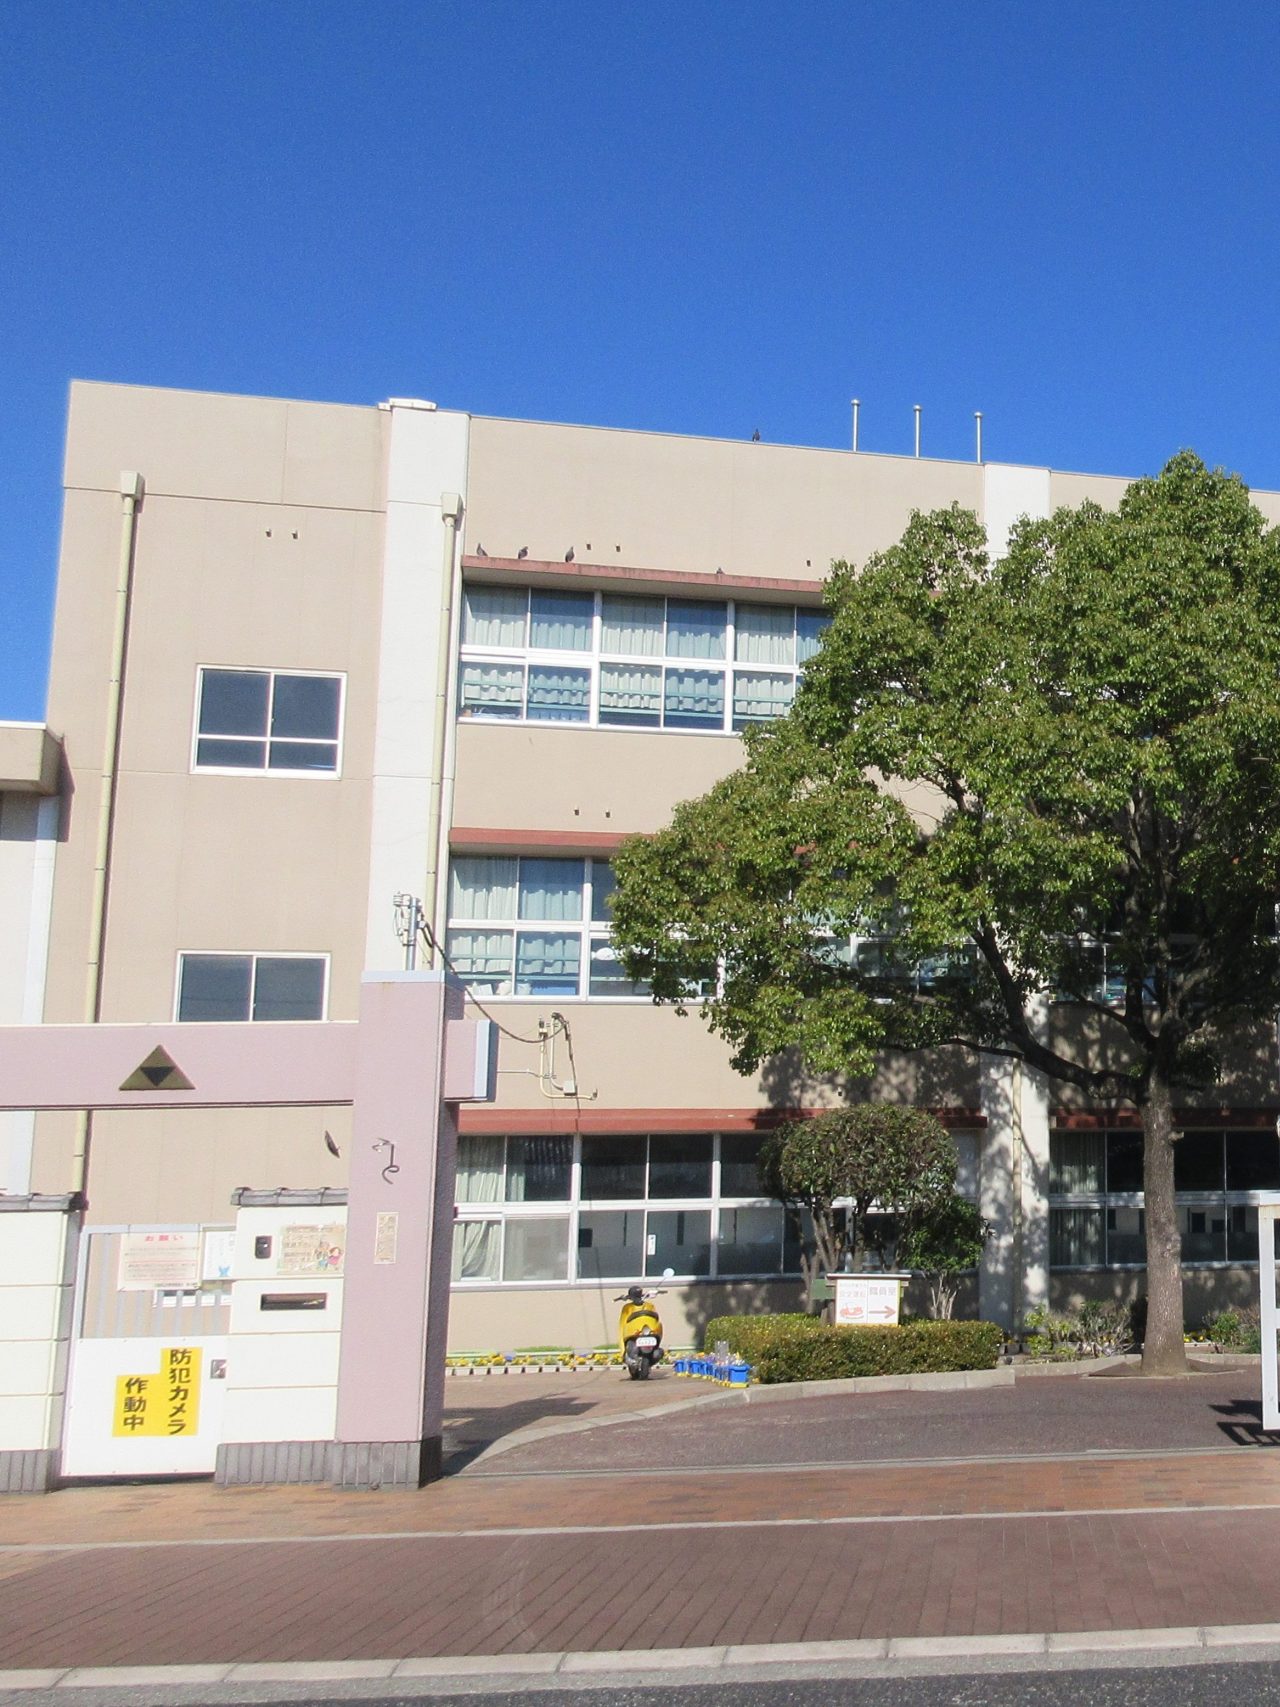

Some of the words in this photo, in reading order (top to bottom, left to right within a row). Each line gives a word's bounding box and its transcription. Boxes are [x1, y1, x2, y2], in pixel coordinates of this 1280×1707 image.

[123, 1377, 149, 1431] 作動中
[168, 1348, 192, 1435] 防犯カメラ
